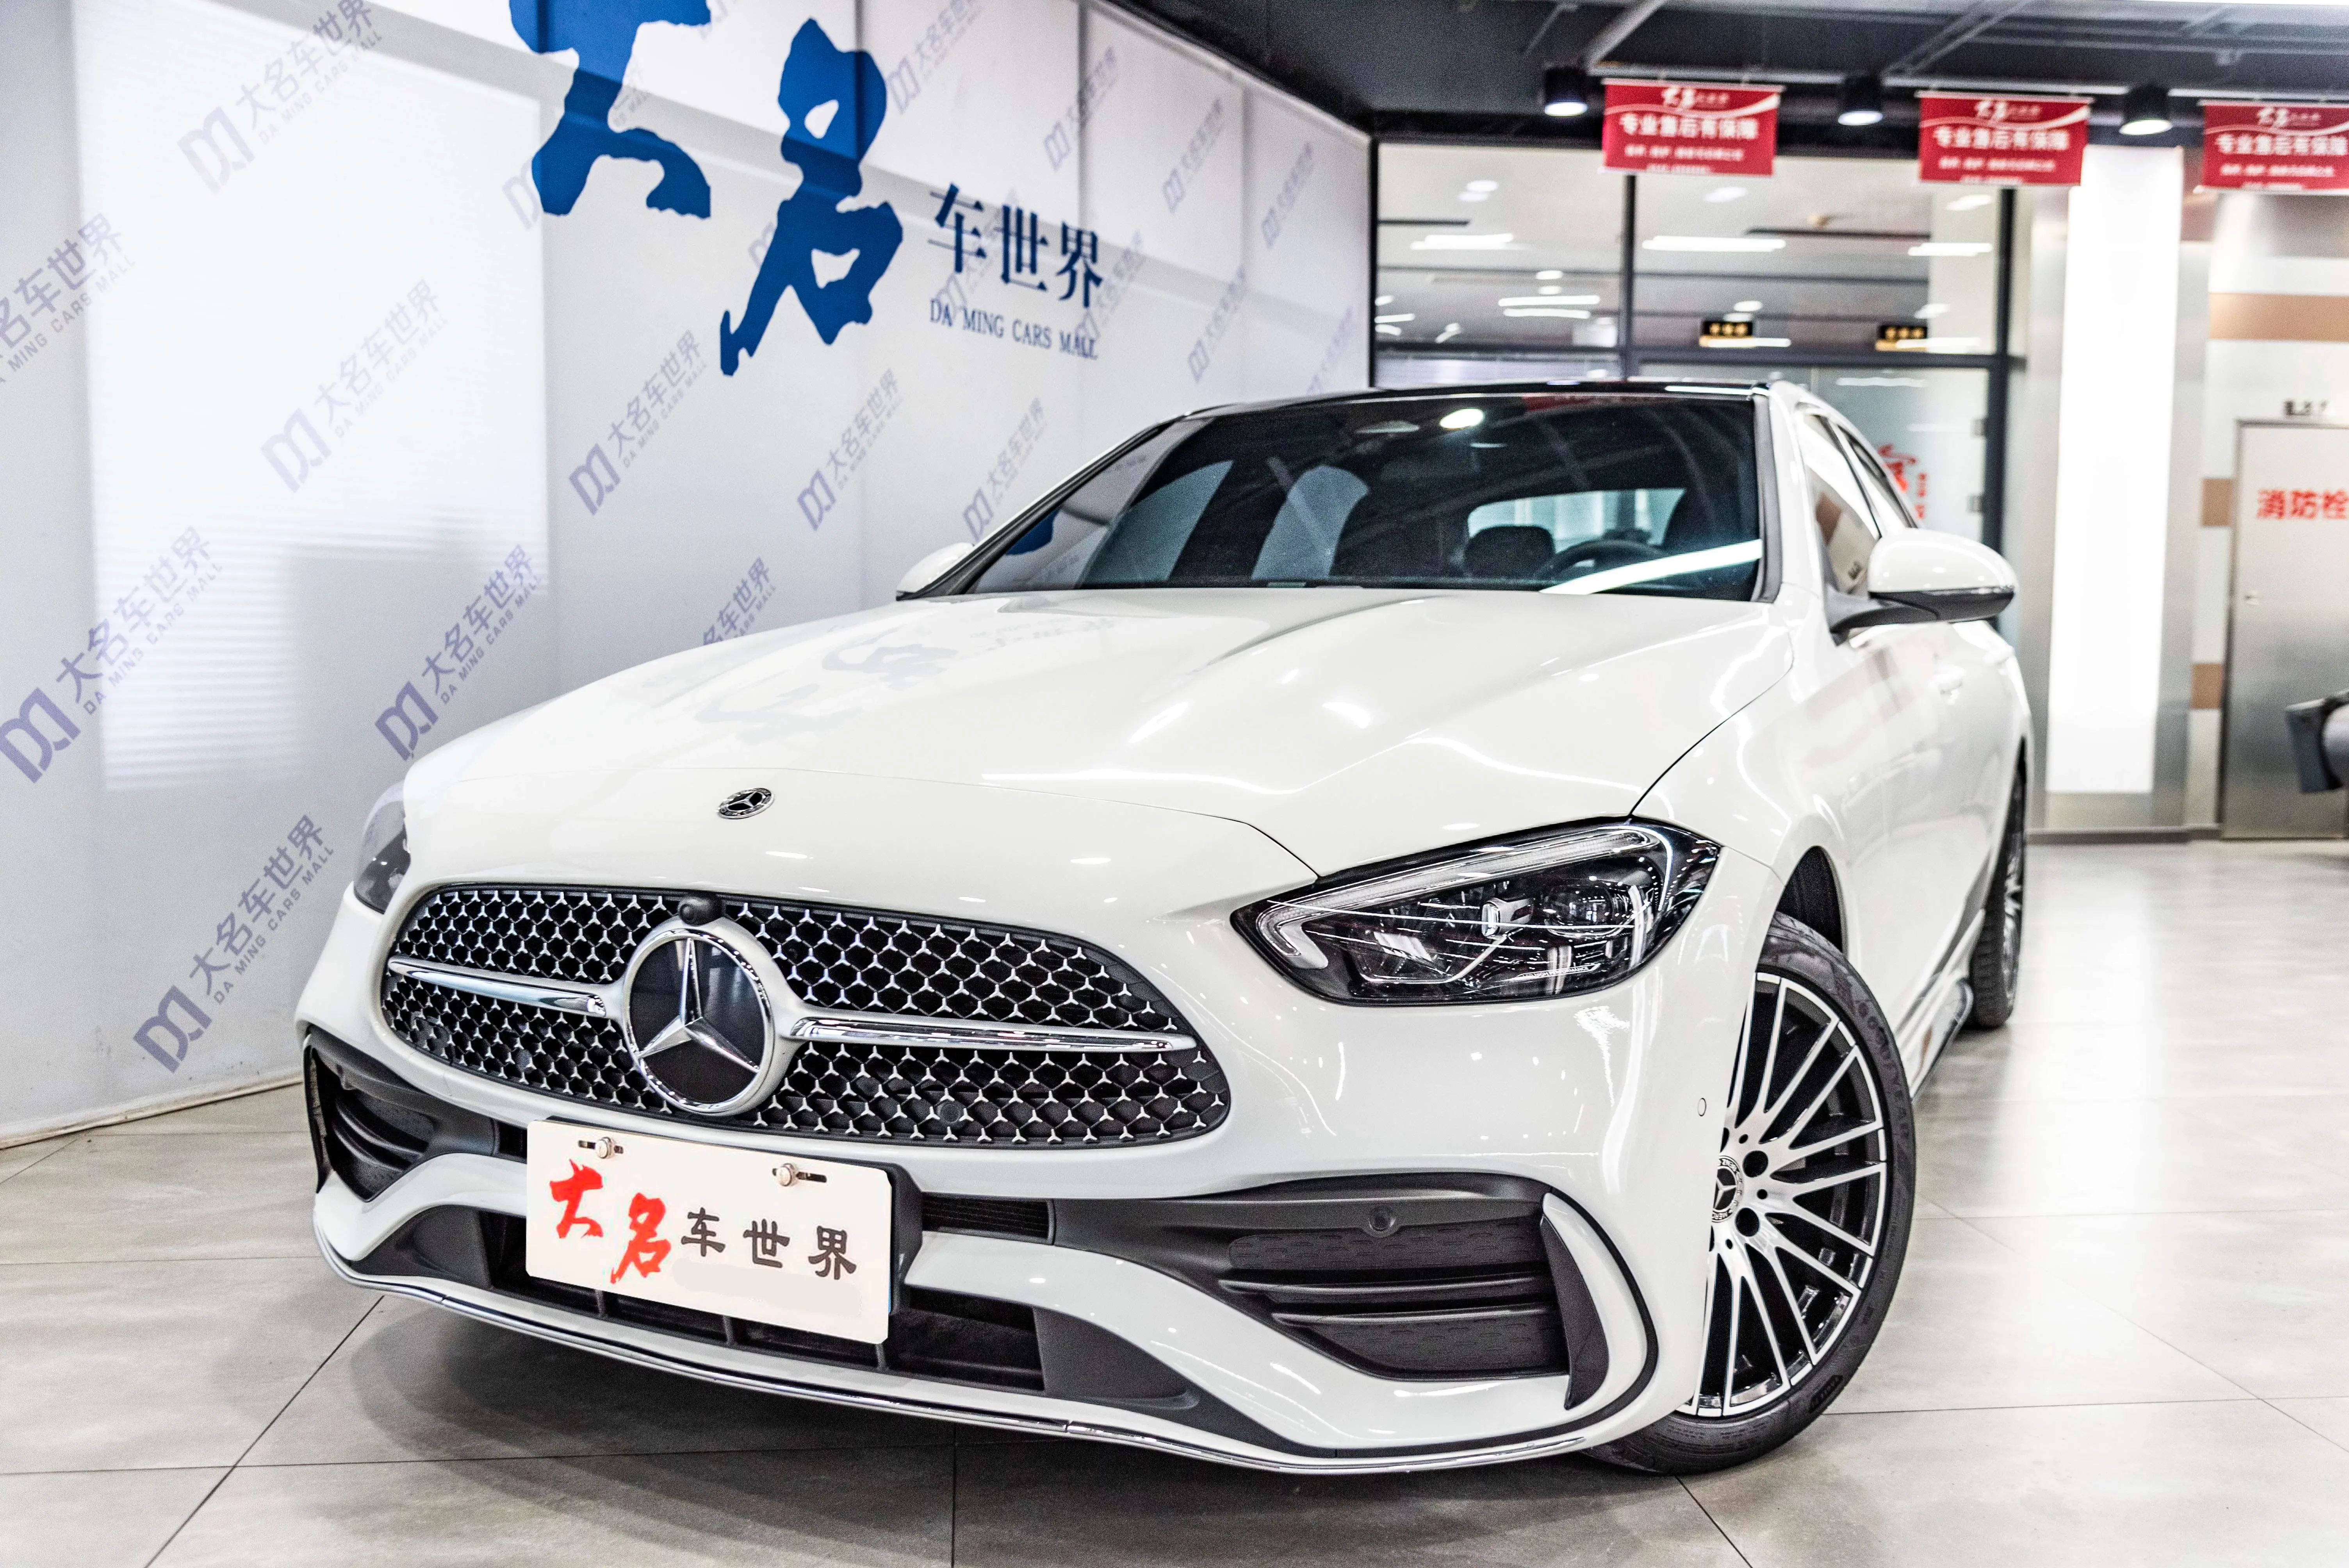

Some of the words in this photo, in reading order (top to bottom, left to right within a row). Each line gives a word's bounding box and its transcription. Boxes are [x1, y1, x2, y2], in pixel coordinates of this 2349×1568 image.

[281, 92, 312, 123] MING
[314, 60, 348, 93] CARS
[927, 182, 1103, 308] 车世界
[7, 332, 48, 372] MING
[50, 292, 93, 333] CARS
[94, 255, 136, 293] MALL
[314, 278, 438, 427] 大名车世界
[929, 298, 953, 327] DA
[963, 308, 1005, 339] MING
[1012, 318, 1052, 350] CARS
[1059, 330, 1100, 361] MALL
[608, 328, 700, 458] 大名车世界
[55, 525, 211, 703] 大名车世界
[82, 690, 107, 715] DA
[108, 649, 144, 687] MING
[145, 602, 185, 645] CARS
[186, 562, 223, 602] MALL
[421, 543, 532, 696] 大名车世界
[440, 684, 458, 705] DA
[458, 646, 485, 682] MING
[485, 609, 514, 646] CARS
[514, 575, 542, 608] MALL
[189, 814, 323, 996] 大名车世界
[213, 980, 234, 1005] DA
[234, 934, 267, 976] MING
[267, 887, 302, 932] CARS
[301, 847, 334, 886] MALL
[550, 1159, 672, 1285] 大名
[681, 1207, 857, 1281] 车世界
